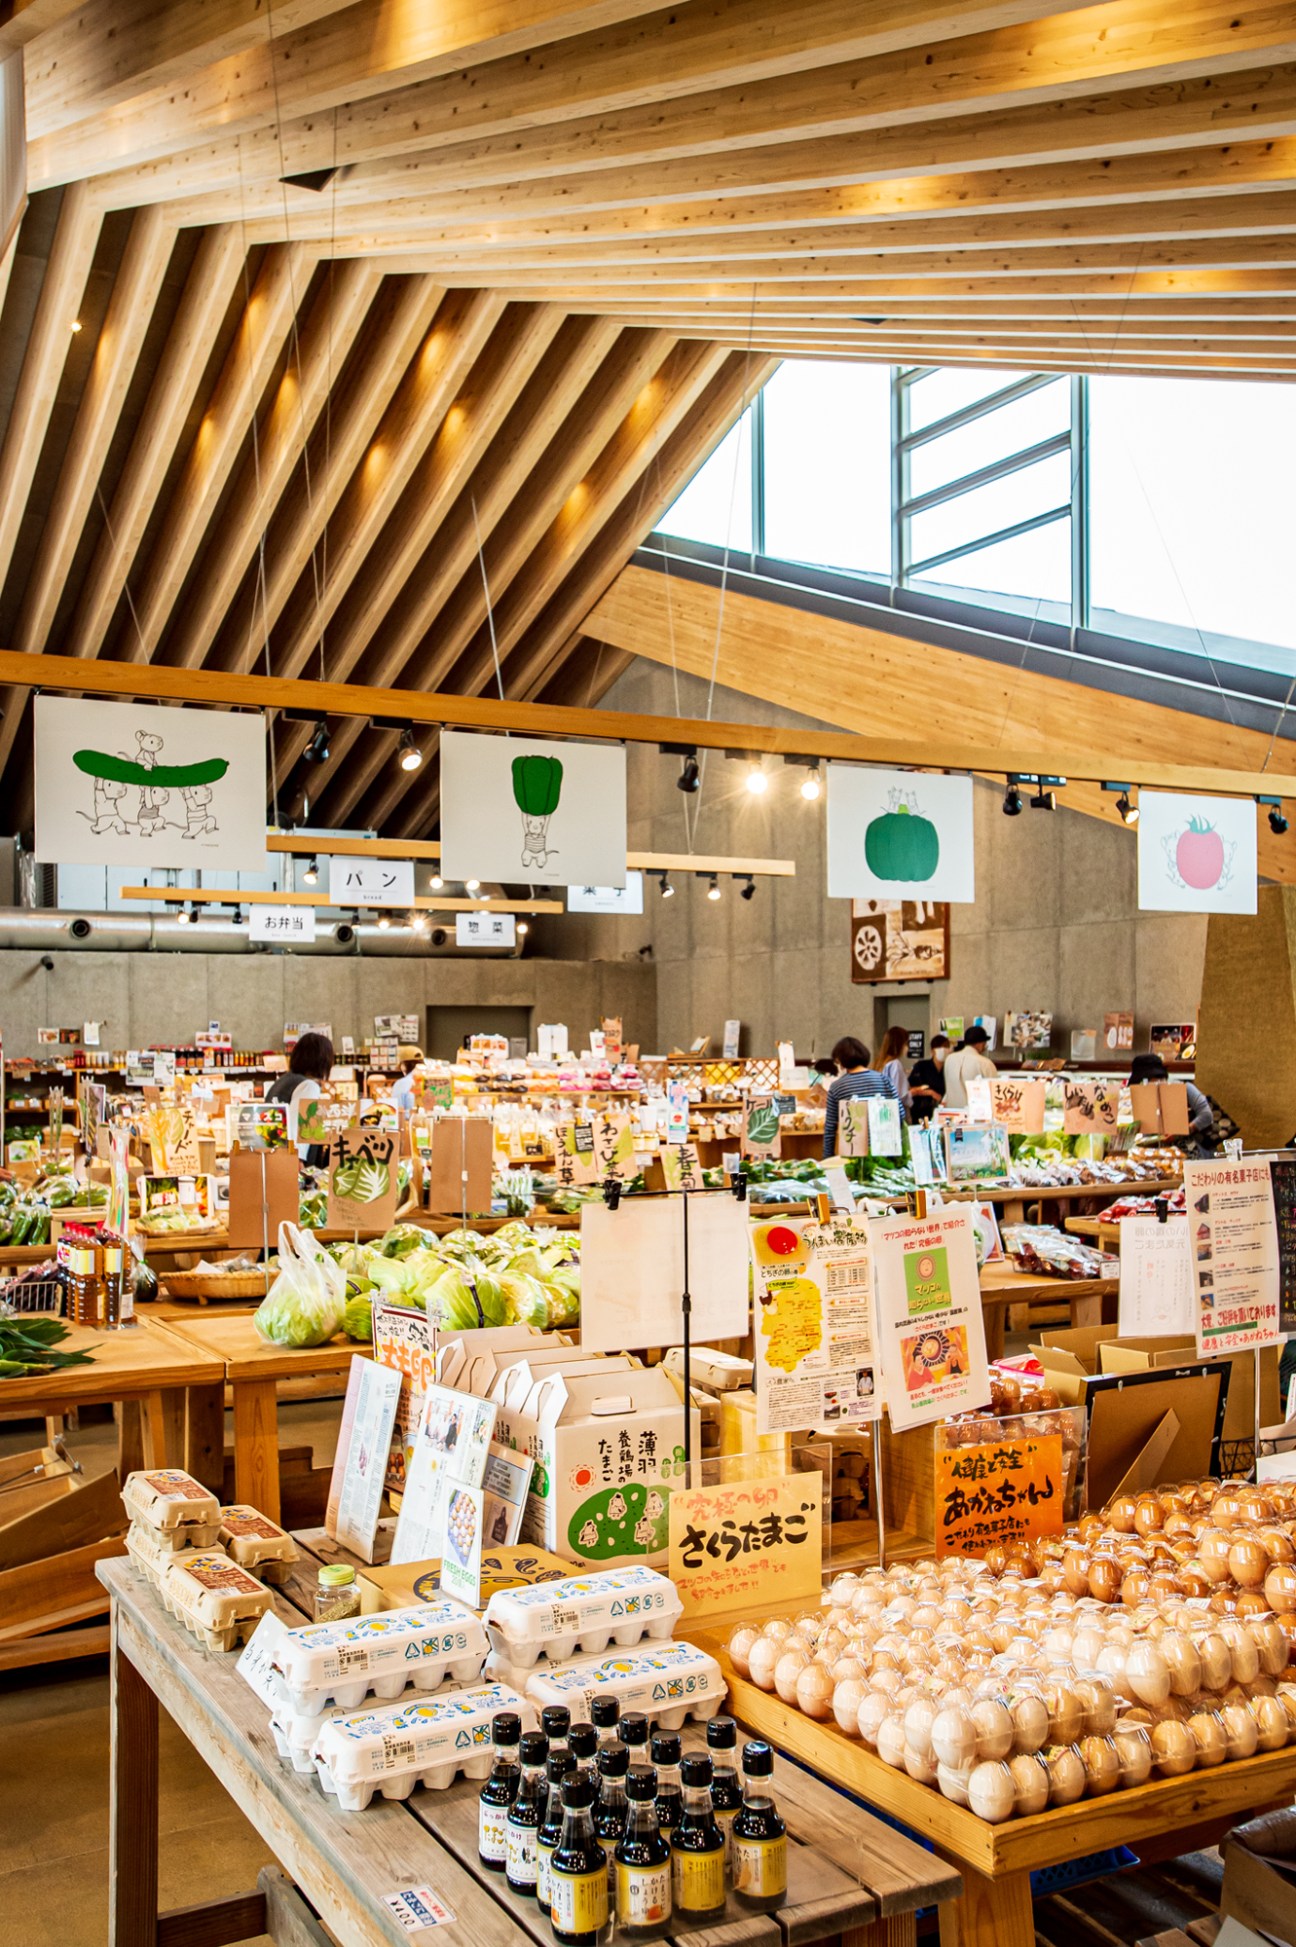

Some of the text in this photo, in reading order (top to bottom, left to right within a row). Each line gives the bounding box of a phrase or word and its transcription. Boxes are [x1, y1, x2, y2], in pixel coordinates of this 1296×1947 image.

[346, 870, 397, 888] パン
[265, 916, 304, 930] お弁当
[332, 1134, 394, 1170] キャベツ
[555, 1127, 575, 1184] ほうれん草
[600, 1122, 625, 1180] わさび菜
[598, 1438, 614, 1482] たまご
[617, 1429, 635, 1483] 養鶏場の
[637, 1430, 658, 1474] 薄羽
[943, 1474, 1054, 1527] あかねちゃん
[678, 1502, 816, 1569] さくらたまご
[443, 1559, 462, 1576] FRESH
[461, 1569, 477, 1586] EGGS
